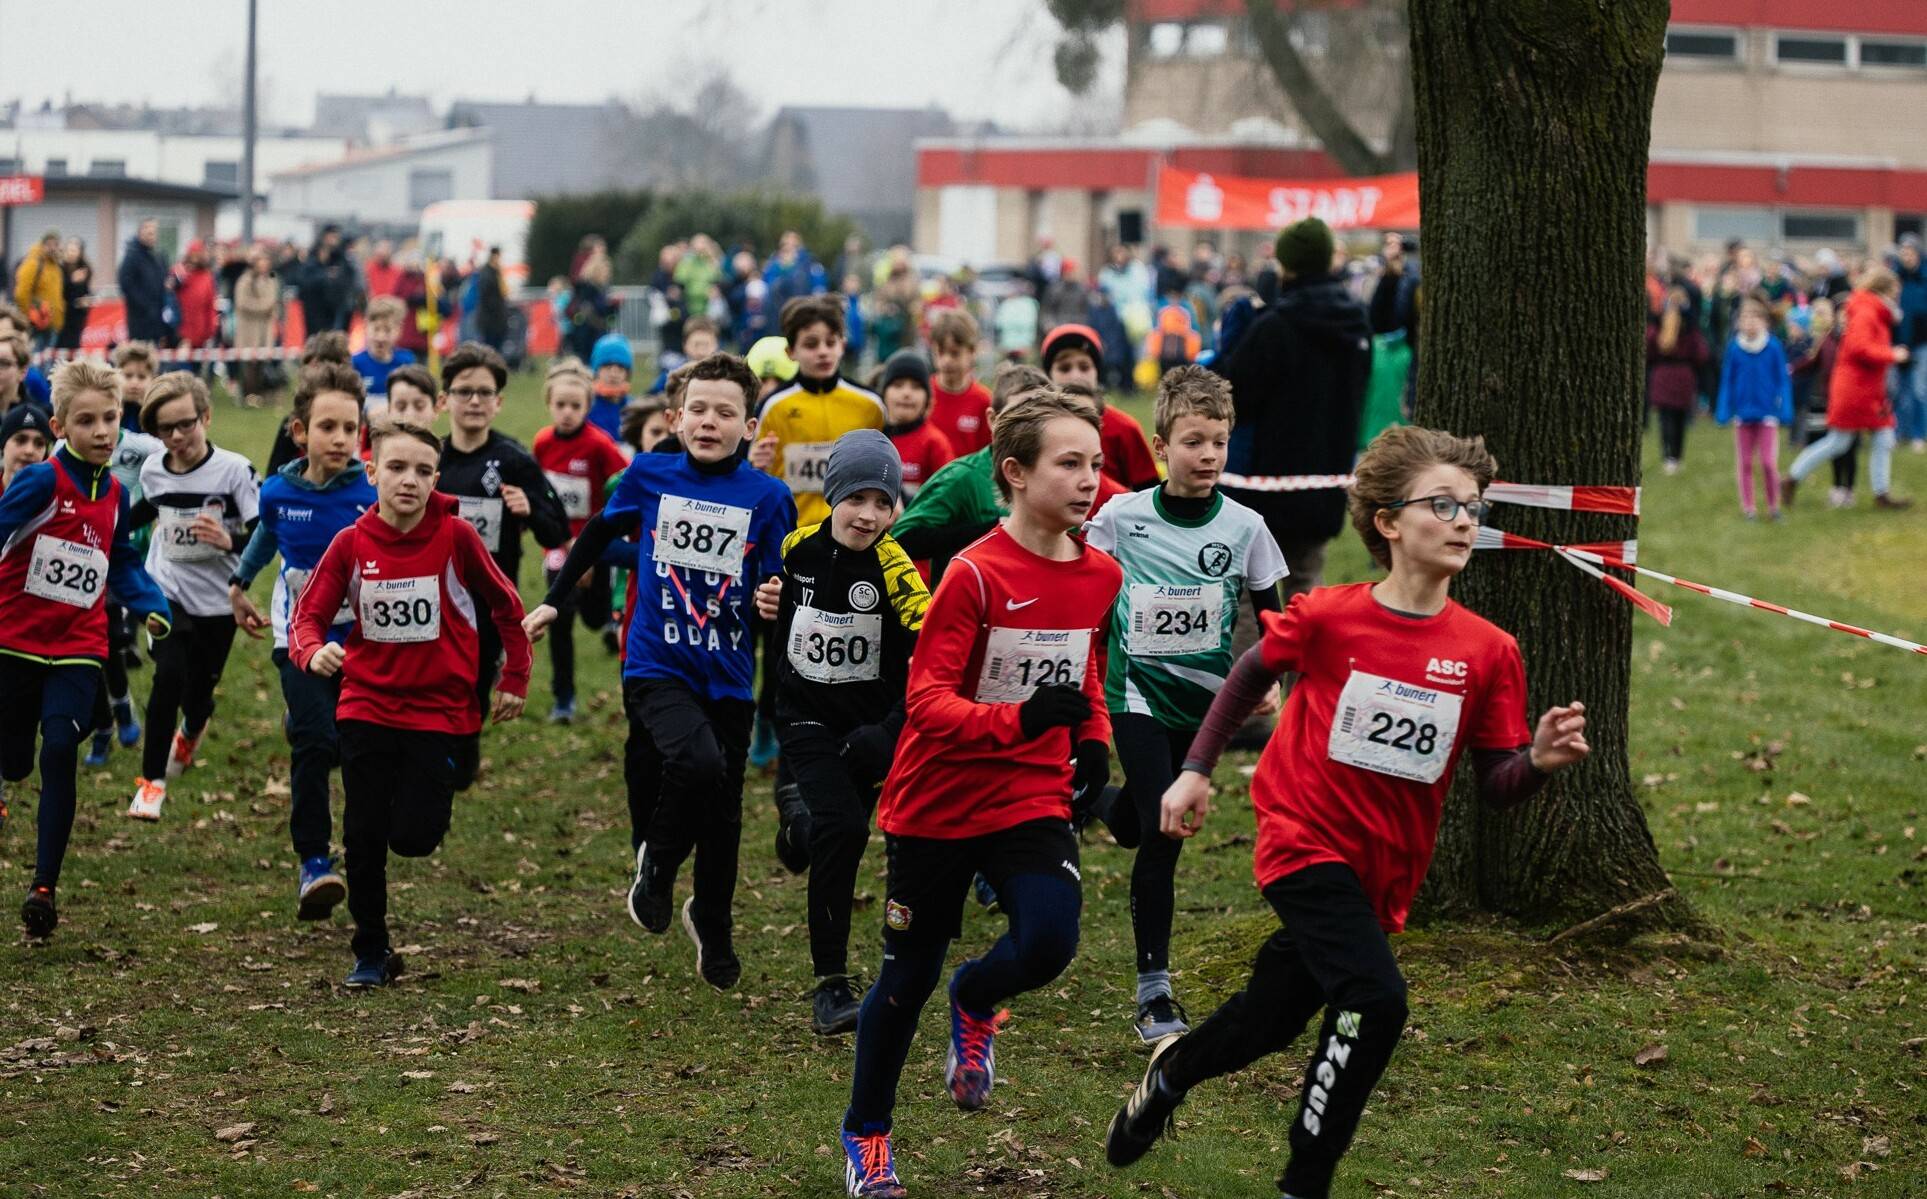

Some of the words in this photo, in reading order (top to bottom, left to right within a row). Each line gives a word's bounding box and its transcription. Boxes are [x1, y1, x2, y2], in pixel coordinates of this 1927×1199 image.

[1266, 186, 1382, 227] START
[800, 459, 829, 480] 40
[695, 502, 727, 515] bunert
[174, 526, 198, 546] 25
[673, 520, 737, 556] 387
[46, 559, 98, 593] 328
[386, 580, 416, 590] bunert
[1168, 586, 1202, 596] bunert
[373, 598, 432, 627] 330
[825, 613, 855, 625] bunert
[1155, 609, 1208, 635] 234
[1035, 631, 1070, 642] bunert
[807, 633, 868, 667] 360
[1018, 658, 1072, 688] 126
[1425, 658, 1469, 677] ASC
[1395, 684, 1438, 703] bunert
[1368, 712, 1438, 755] 228
